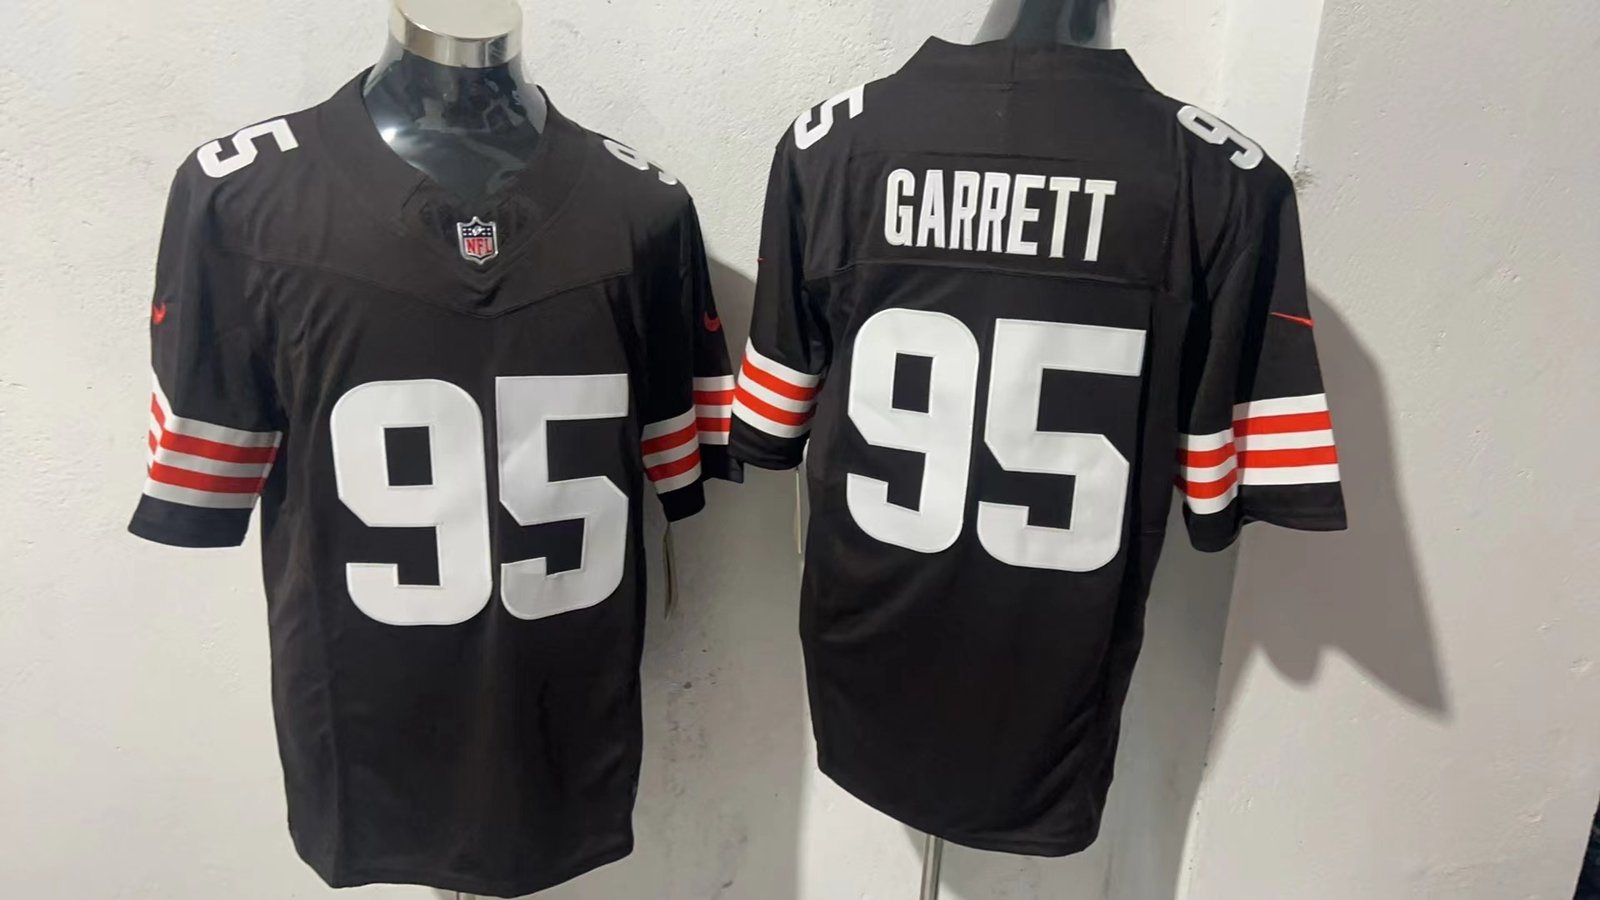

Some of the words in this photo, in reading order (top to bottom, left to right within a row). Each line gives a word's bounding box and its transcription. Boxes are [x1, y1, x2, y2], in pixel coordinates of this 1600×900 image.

[197, 118, 299, 178] 5
[465, 238, 493, 256] NFL
[885, 169, 1118, 262] GARRETT
[846, 308, 1146, 571] 95
[330, 374, 628, 626] 95
